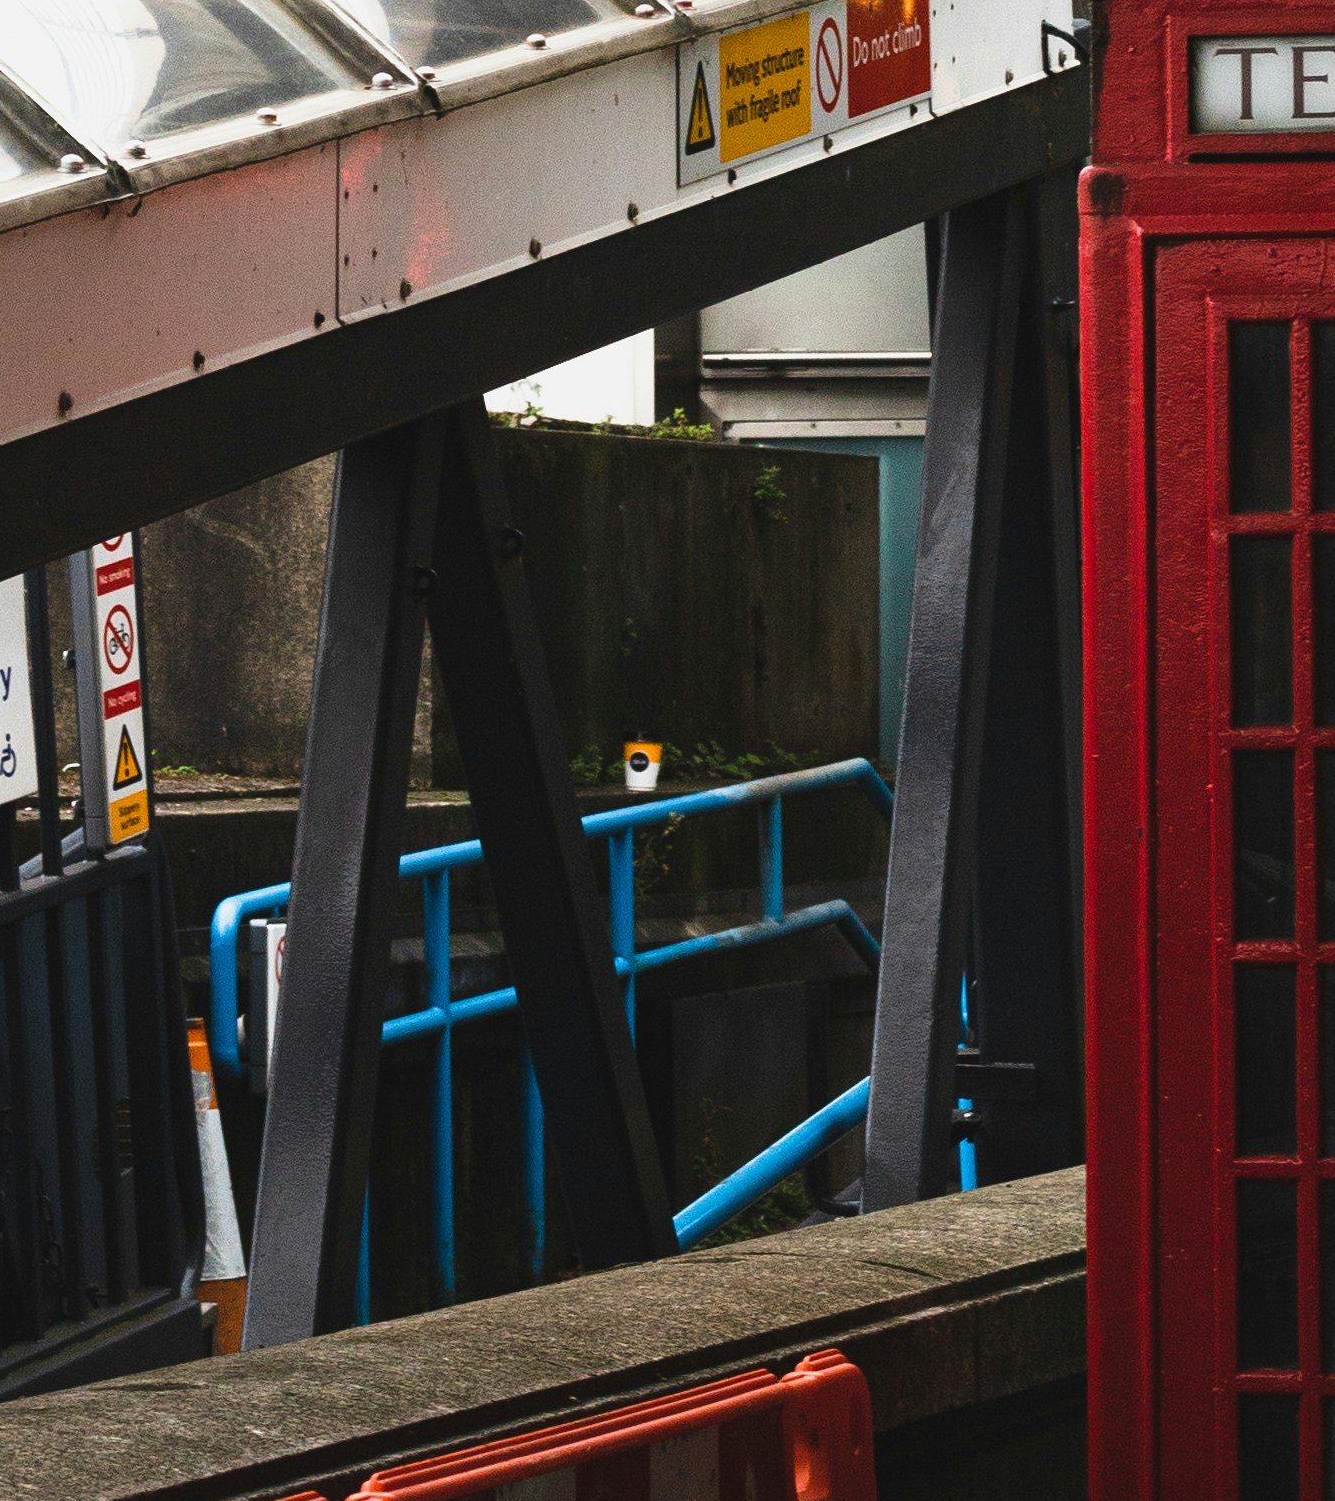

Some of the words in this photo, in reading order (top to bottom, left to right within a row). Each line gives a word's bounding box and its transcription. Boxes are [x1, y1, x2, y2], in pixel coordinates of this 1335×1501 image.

[852, 36, 869, 68] Do
[871, 29, 891, 61] not
[892, 17, 922, 54] climb
[726, 58, 760, 90] Moving
[761, 47, 804, 78] structure
[726, 98, 748, 129] with
[749, 89, 780, 123] fragile
[781, 79, 801, 110] roof
